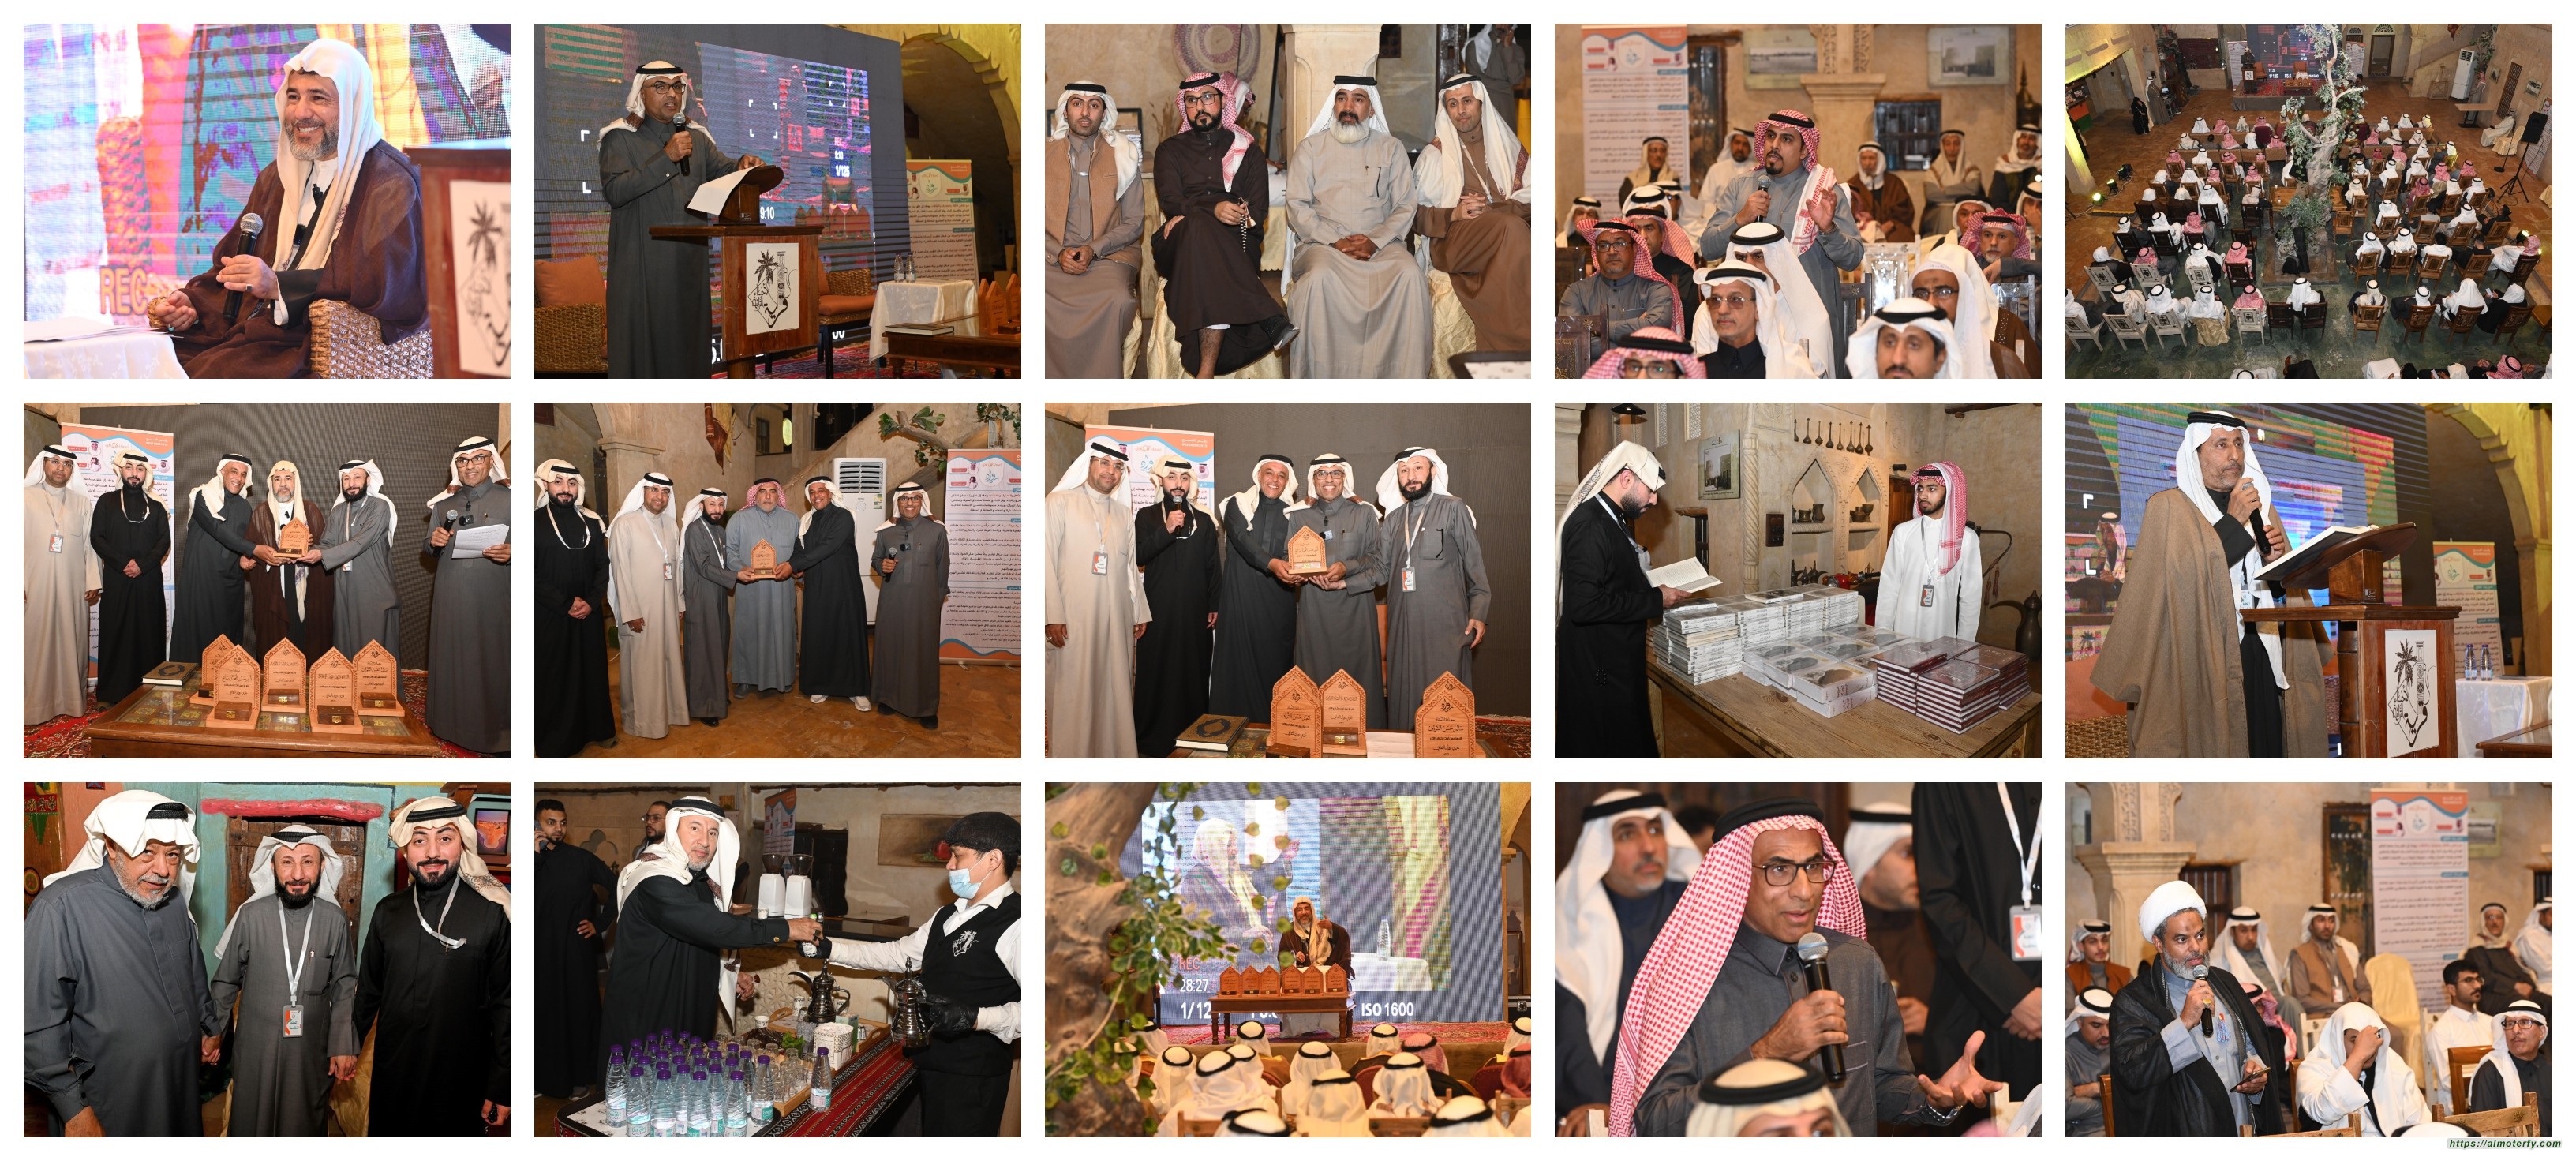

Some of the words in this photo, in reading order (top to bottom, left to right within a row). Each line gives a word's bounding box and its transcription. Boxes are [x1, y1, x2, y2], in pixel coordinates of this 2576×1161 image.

[760, 206, 775, 220] 9:10
[100, 266, 148, 316] REC
[1178, 957, 1200, 971] REC
[1180, 979, 1208, 993] 28:27
[1181, 1002, 1212, 1020] 1/12
[1361, 1002, 1382, 1017] ISO
[1384, 1002, 1414, 1017] 1600
